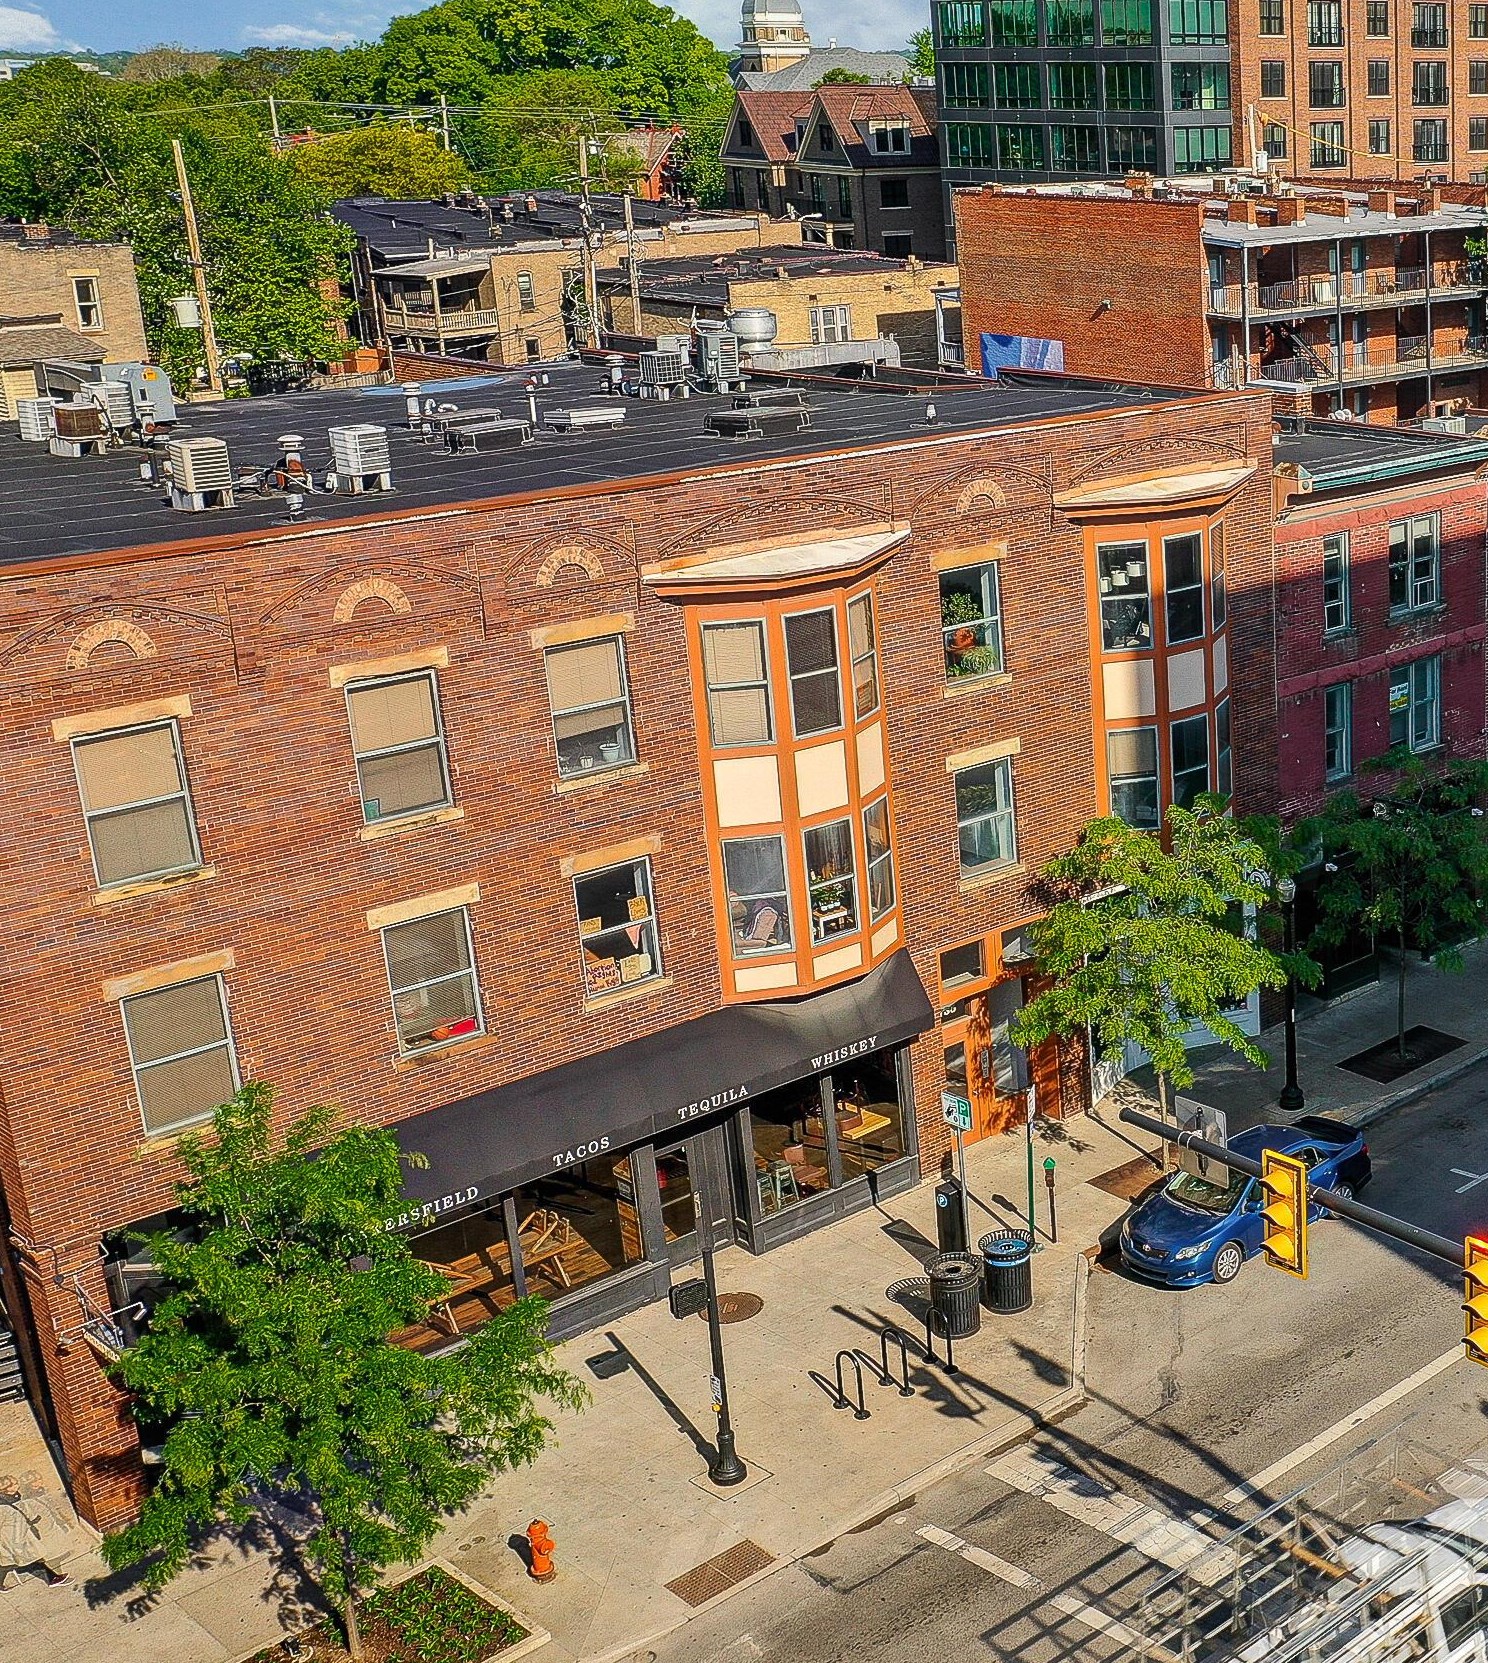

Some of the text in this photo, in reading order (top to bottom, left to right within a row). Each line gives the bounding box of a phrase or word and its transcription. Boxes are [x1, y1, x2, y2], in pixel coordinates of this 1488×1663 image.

[810, 1036, 878, 1069] WHISKEY
[677, 1085, 749, 1120] TEQUILA
[552, 1136, 611, 1167] TACOS
